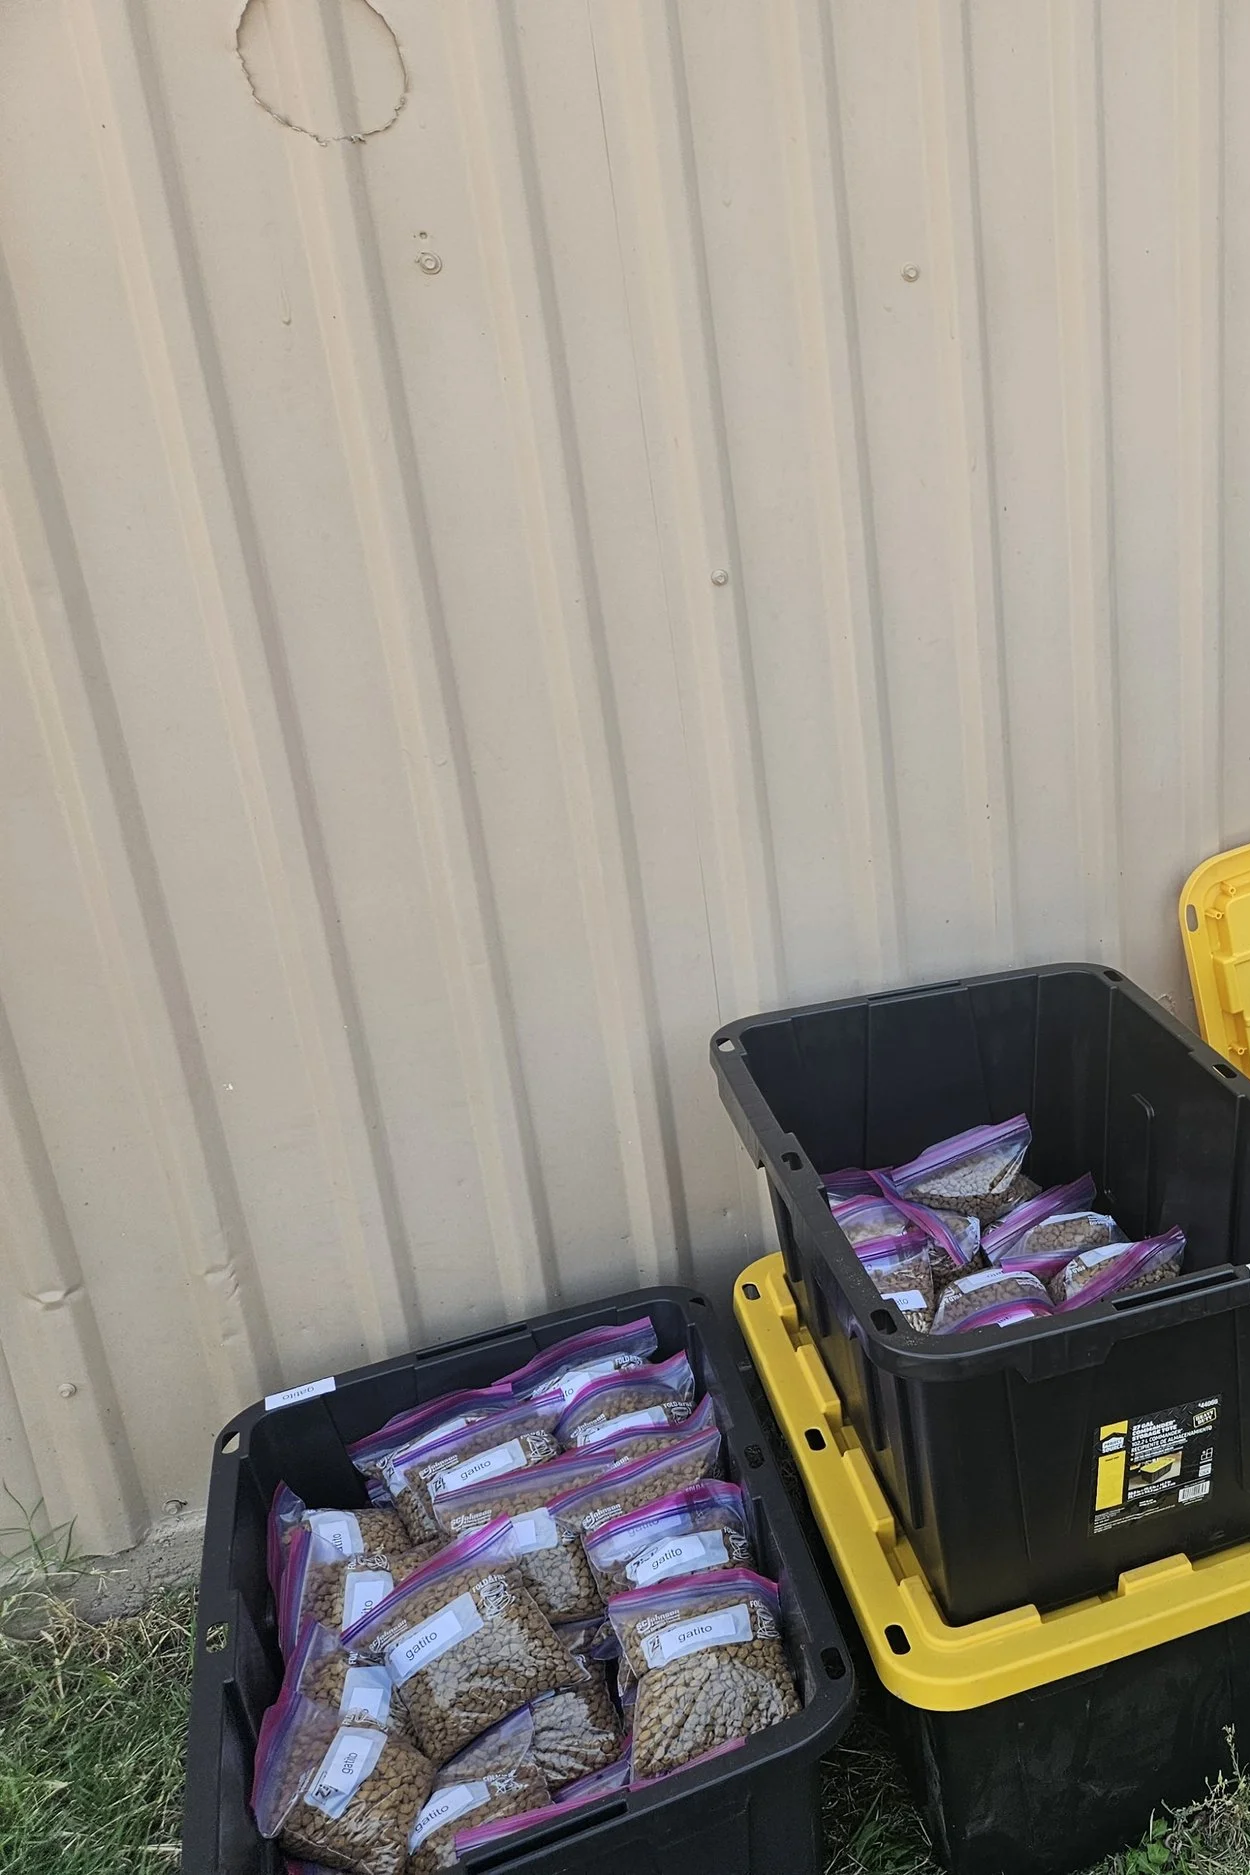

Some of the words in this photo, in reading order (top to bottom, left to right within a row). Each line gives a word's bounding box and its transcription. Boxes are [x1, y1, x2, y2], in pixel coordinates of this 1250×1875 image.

[281, 1386, 315, 1400] gatito
[1131, 1428, 1161, 1442] STORAGE
[1161, 1424, 1178, 1433] TOTE
[1167, 1425, 1213, 1443] ALMACENAMIENTO
[460, 1459, 492, 1481] gatito
[651, 1546, 684, 1570] gatito
[677, 1624, 713, 1643] gatito
[405, 1631, 438, 1661] gatito
[341, 1752, 358, 1775] gatito
[414, 1805, 449, 1833] gatito
